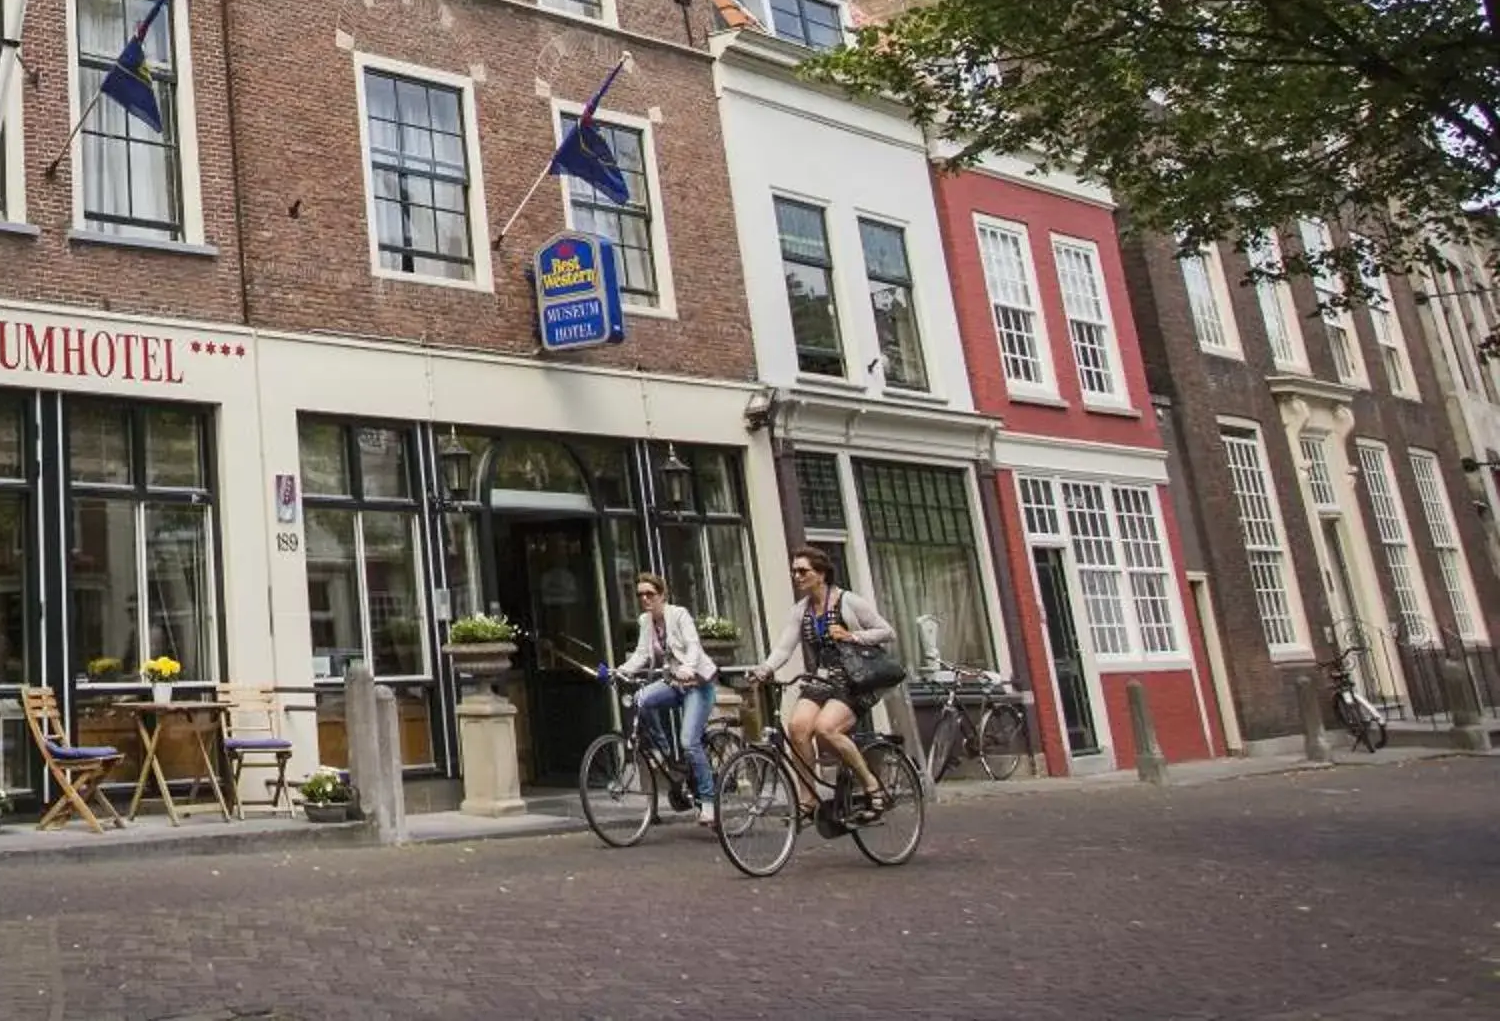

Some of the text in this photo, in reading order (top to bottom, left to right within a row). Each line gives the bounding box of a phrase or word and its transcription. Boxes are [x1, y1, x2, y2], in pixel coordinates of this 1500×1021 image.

[550, 255, 581, 276] Best
[542, 268, 597, 290] Western
[546, 300, 600, 324] MUSEUM
[554, 323, 597, 342] HOTEL
[276, 532, 299, 552] 189
